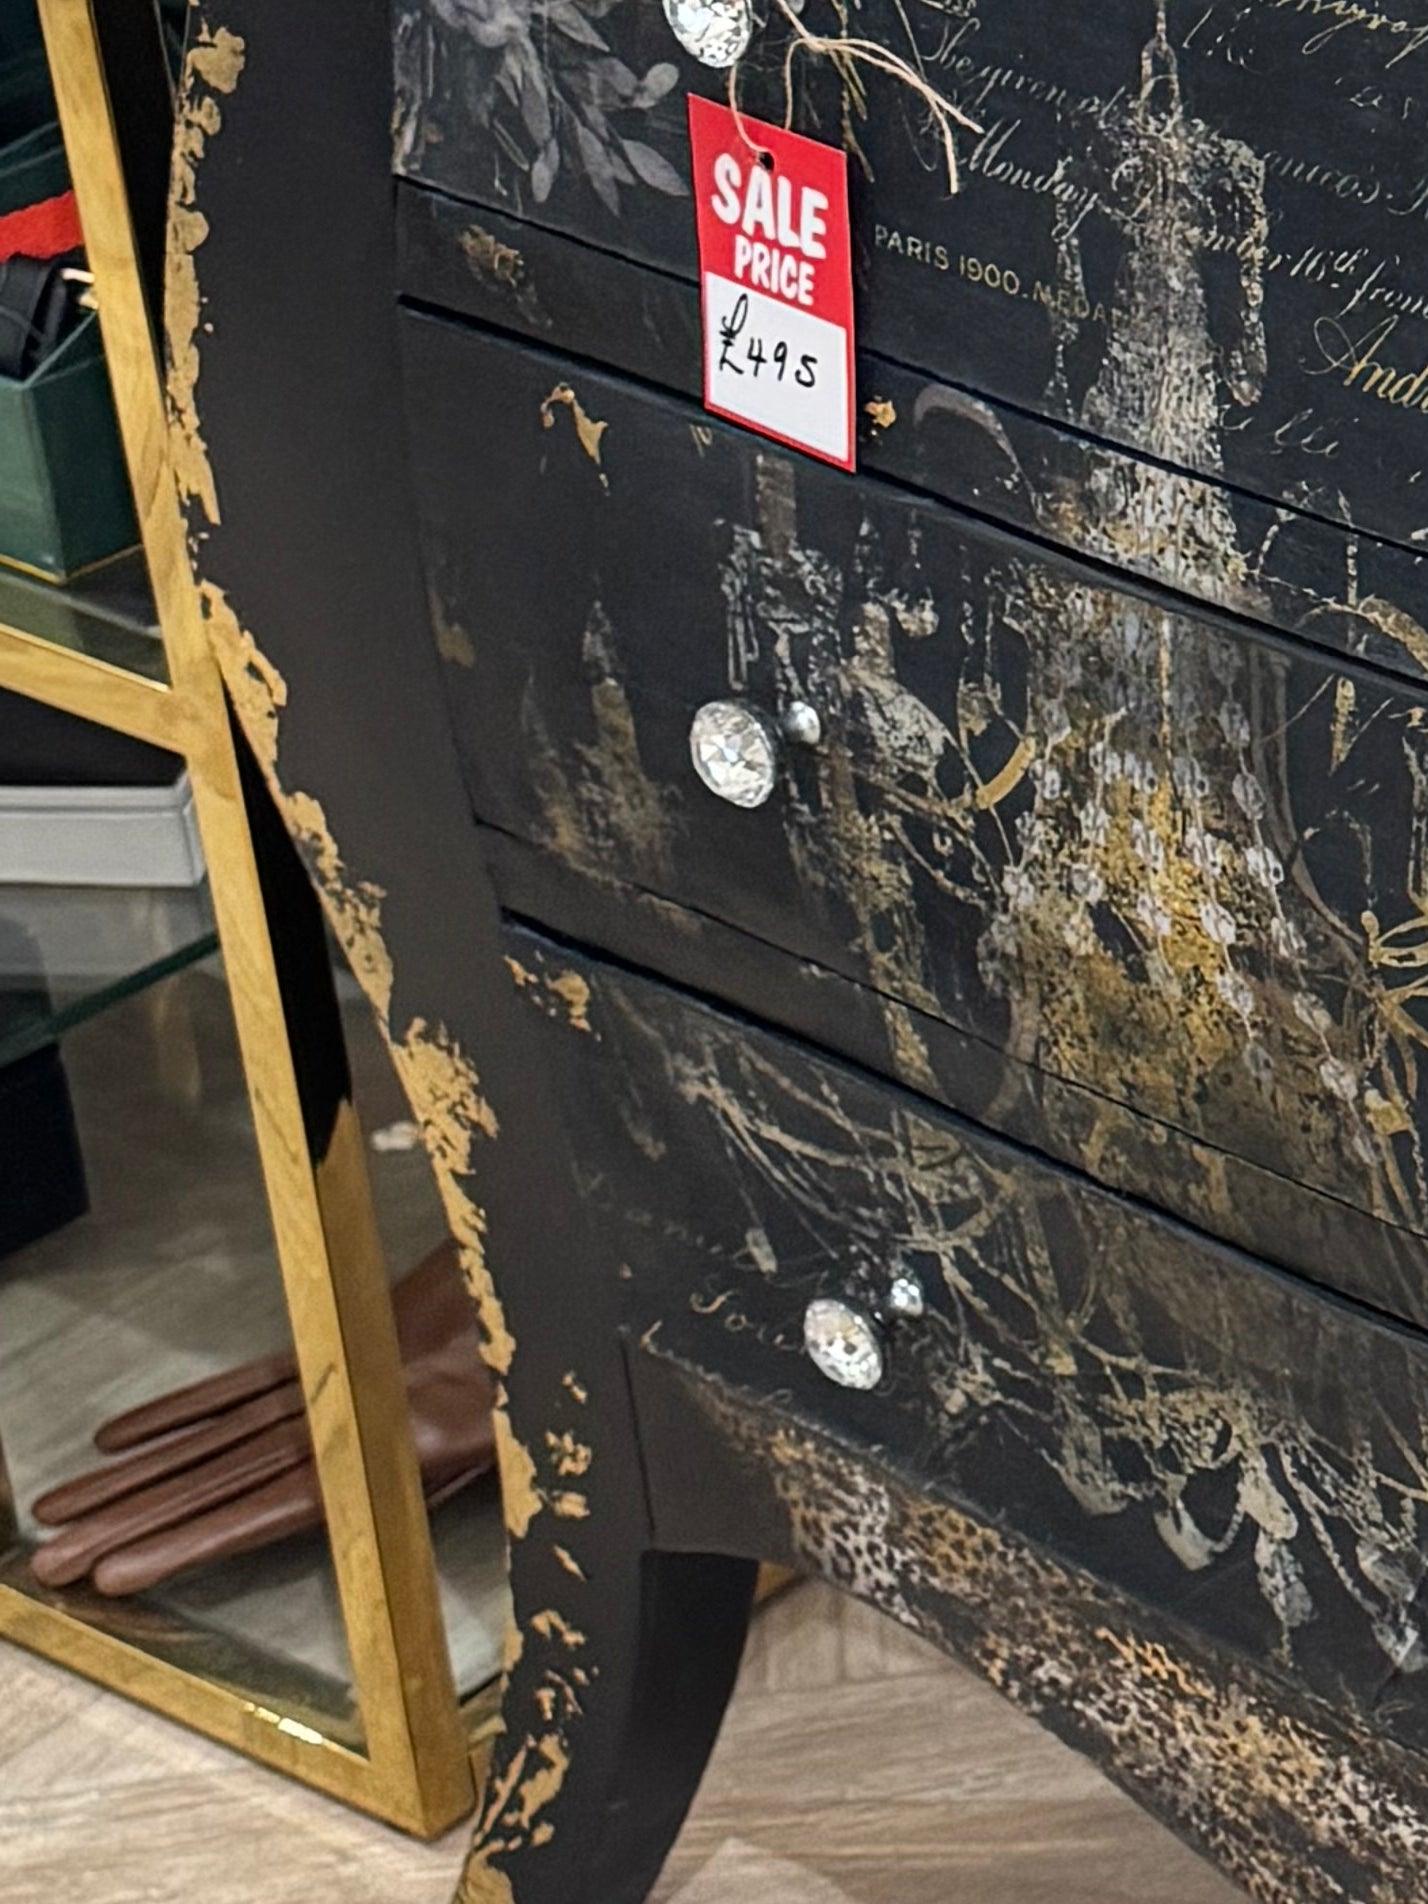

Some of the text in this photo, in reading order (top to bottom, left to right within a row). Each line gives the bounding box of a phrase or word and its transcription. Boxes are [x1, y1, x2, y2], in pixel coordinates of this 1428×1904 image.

[710, 152, 830, 260] SALE
[873, 223, 950, 272] PARIS
[733, 234, 815, 307] PRICE
[718, 292, 819, 389] £495
